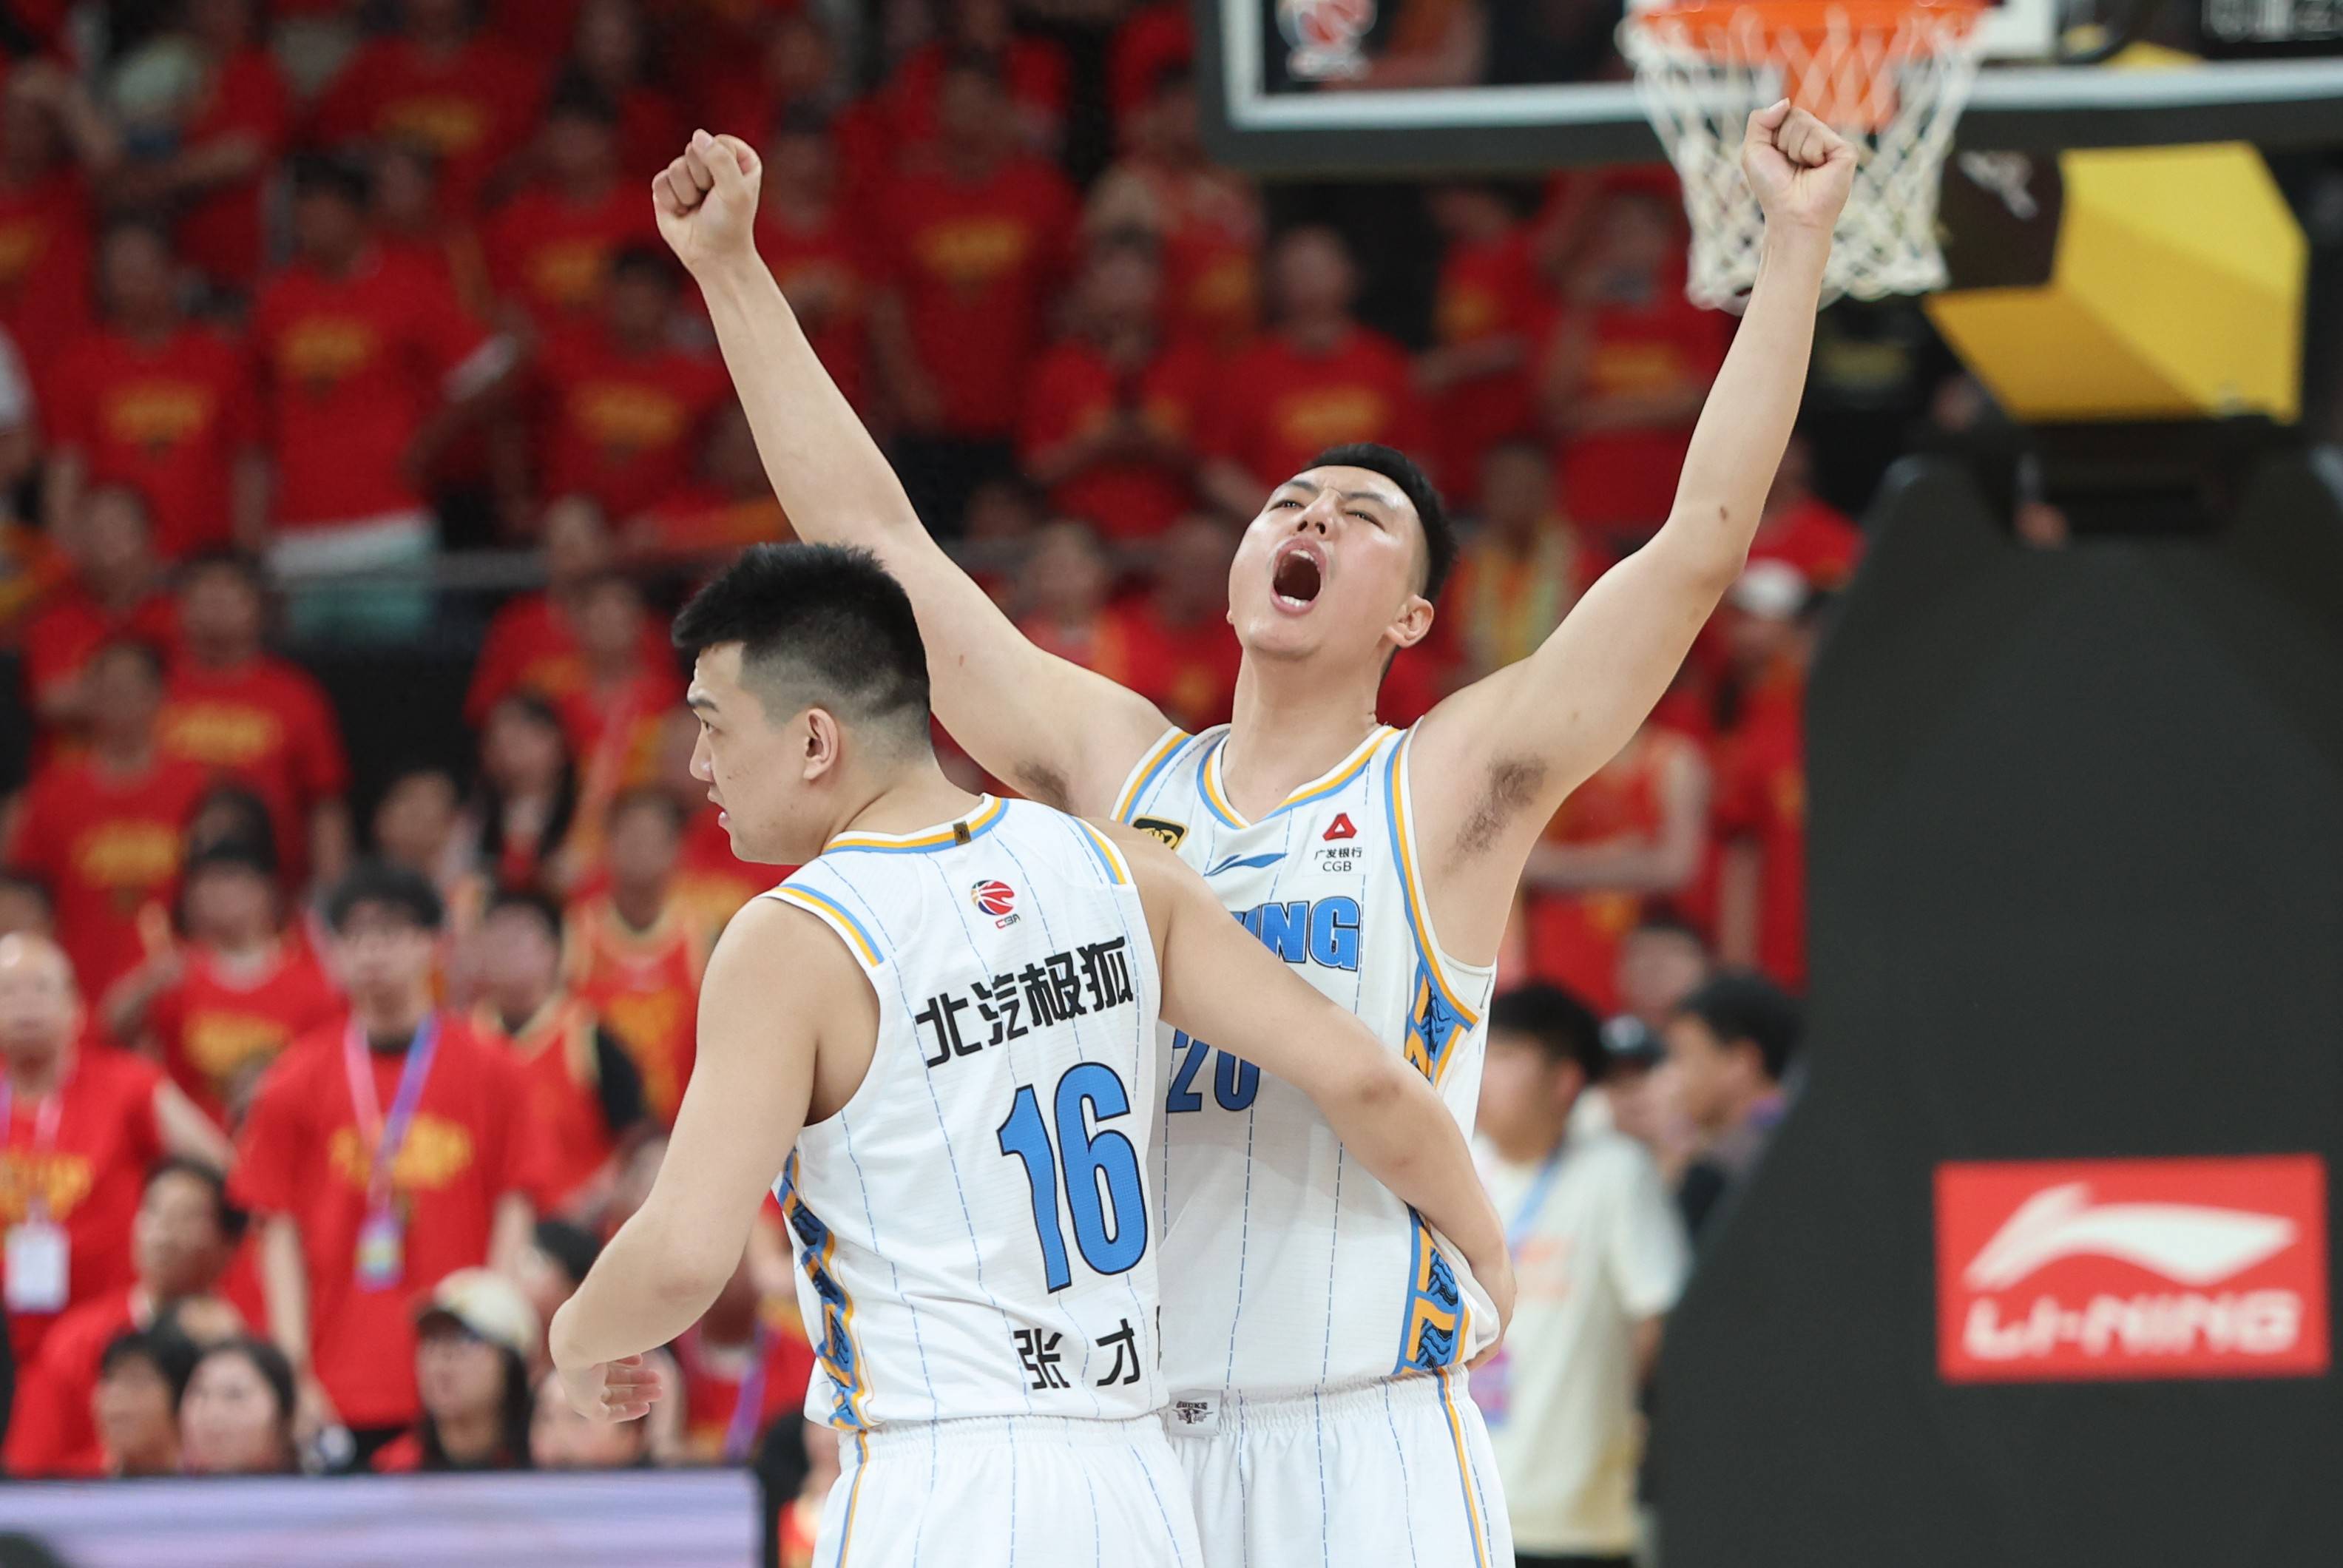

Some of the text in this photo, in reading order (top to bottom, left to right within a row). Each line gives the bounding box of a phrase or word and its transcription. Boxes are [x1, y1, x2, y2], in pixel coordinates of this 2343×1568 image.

[1314, 847, 1362, 860] 广发银行
[1322, 860, 1352, 872] CGB
[914, 936, 1134, 1069] 北汽极狐
[996, 1061, 1147, 1294] 16
[1013, 1306, 1162, 1390] 张才
